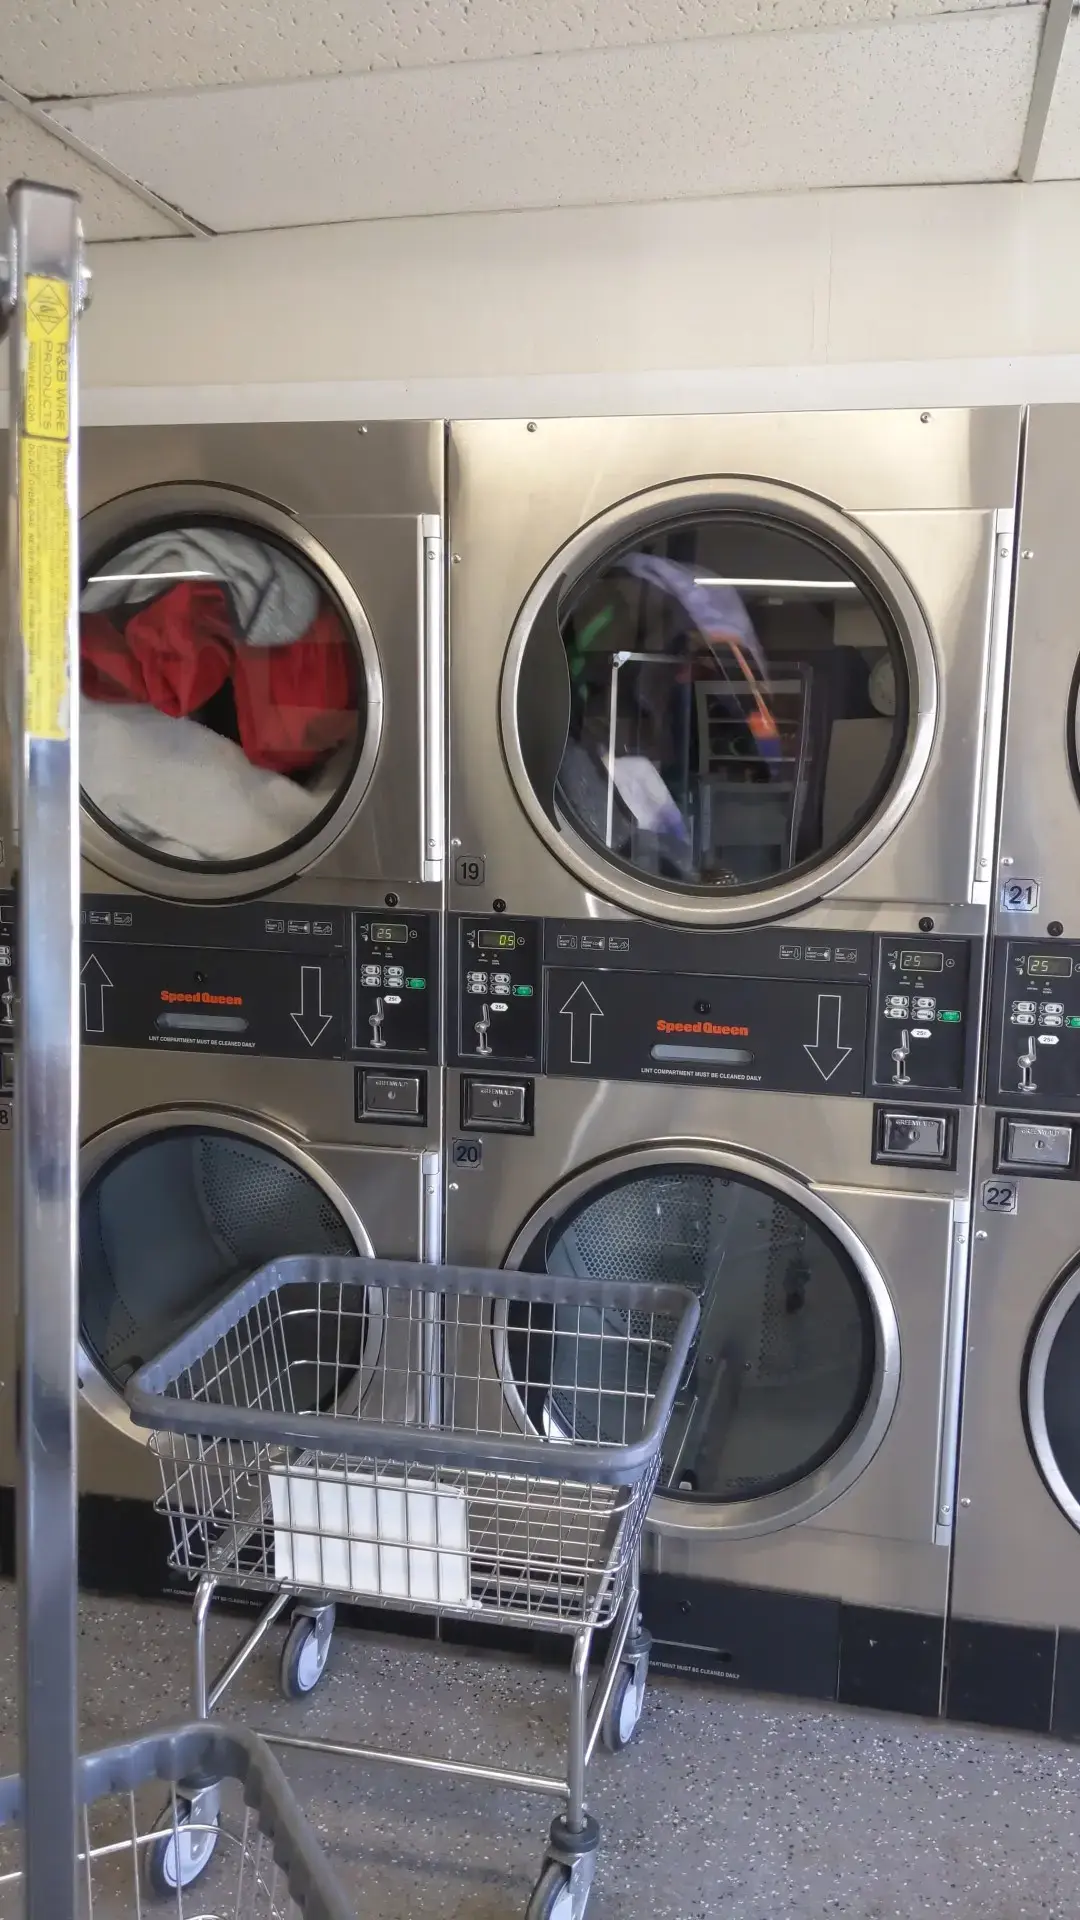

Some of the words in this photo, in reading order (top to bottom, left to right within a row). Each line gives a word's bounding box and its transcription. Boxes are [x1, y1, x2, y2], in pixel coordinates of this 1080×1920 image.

[55, 341, 69, 383] R&B
[42, 339, 54, 430] PRODUCTS
[55, 388, 67, 433] WIRE
[460, 862, 479, 880] 19
[1009, 885, 1033, 905] 21
[376, 928, 392, 939] 25
[499, 934, 515, 946] 05
[903, 955, 922, 967] 25
[1030, 960, 1049, 972] 25
[160, 990, 201, 1003] Speed
[201, 992, 243, 1005] Queen
[656, 1019, 702, 1033] Speed
[702, 1022, 749, 1036] Queen
[160, 1036, 196, 1044] COMPARTMENT
[653, 1068, 694, 1077] COMPARTMENT
[456, 1145, 479, 1163] 20
[986, 1187, 1013, 1206] 22
[699, 1668, 725, 1677] CLEANED
